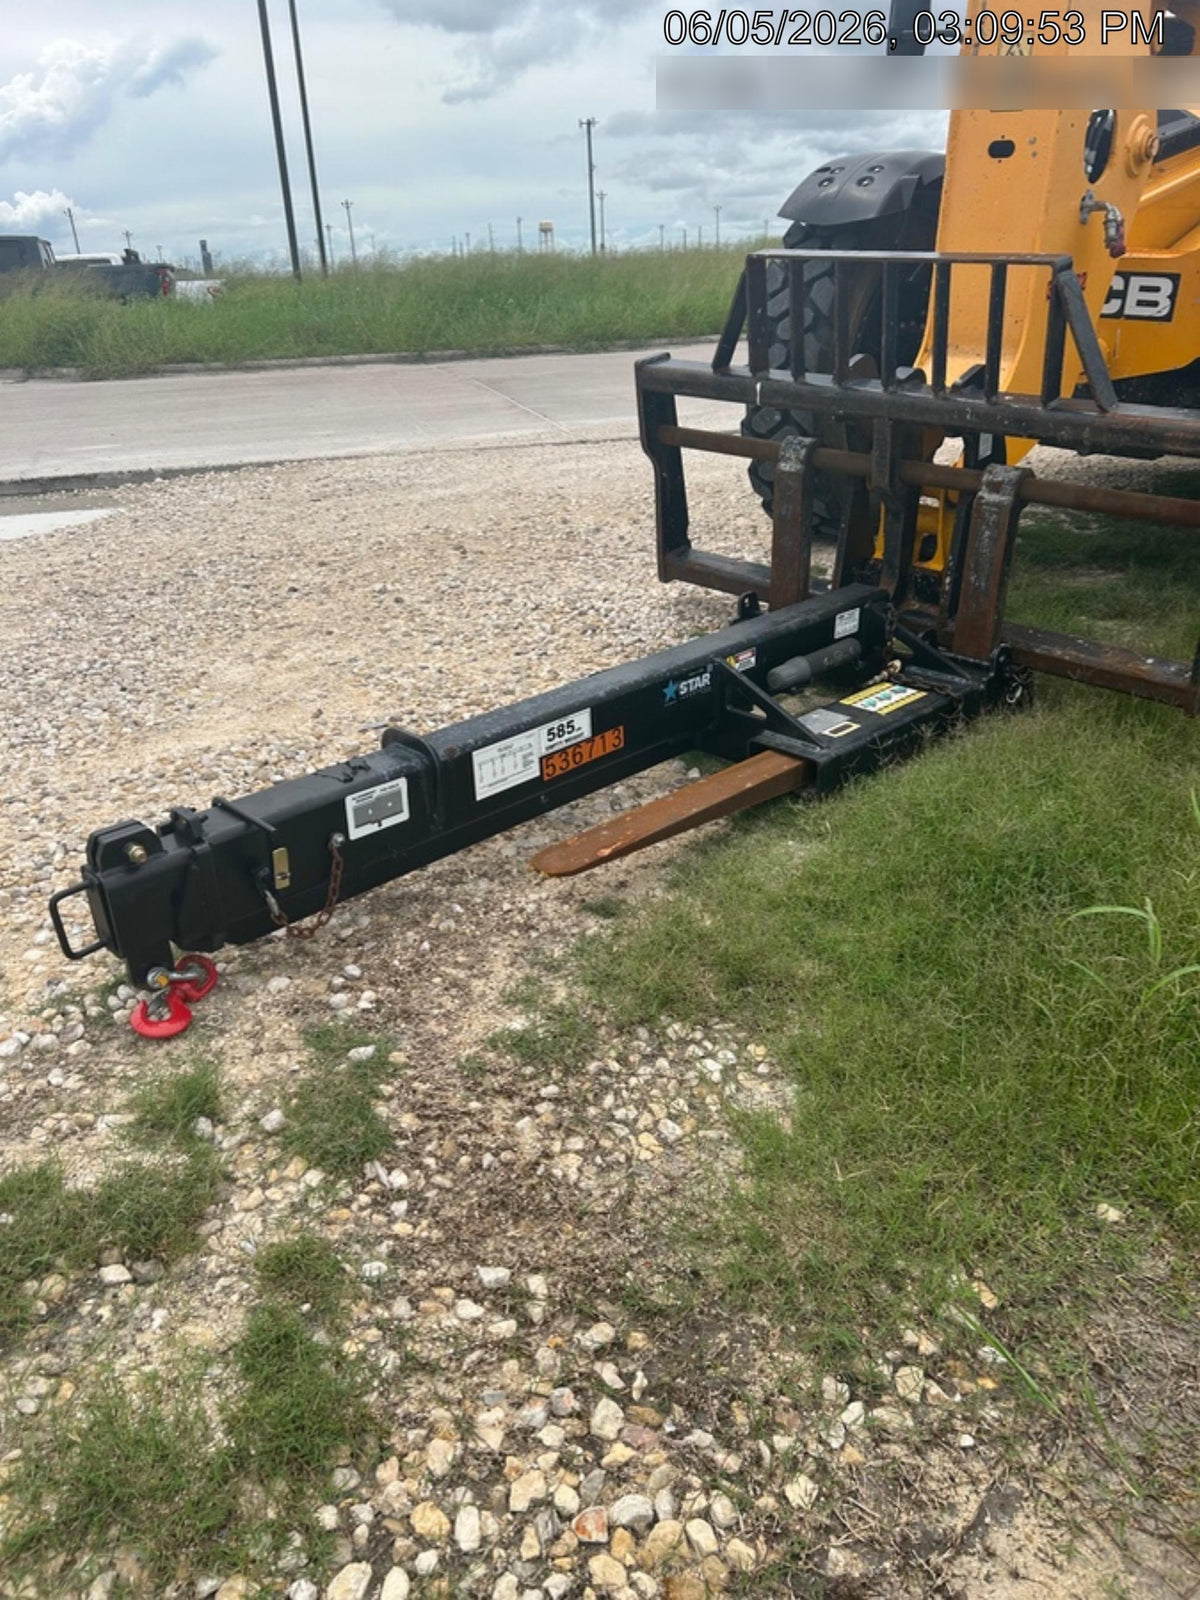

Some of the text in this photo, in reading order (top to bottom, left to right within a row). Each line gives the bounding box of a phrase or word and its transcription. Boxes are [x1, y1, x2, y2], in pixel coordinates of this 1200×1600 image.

[1100, 274, 1174, 318] CB
[678, 672, 711, 695] STAR
[546, 719, 575, 742] 585
[545, 728, 621, 777] 536713
